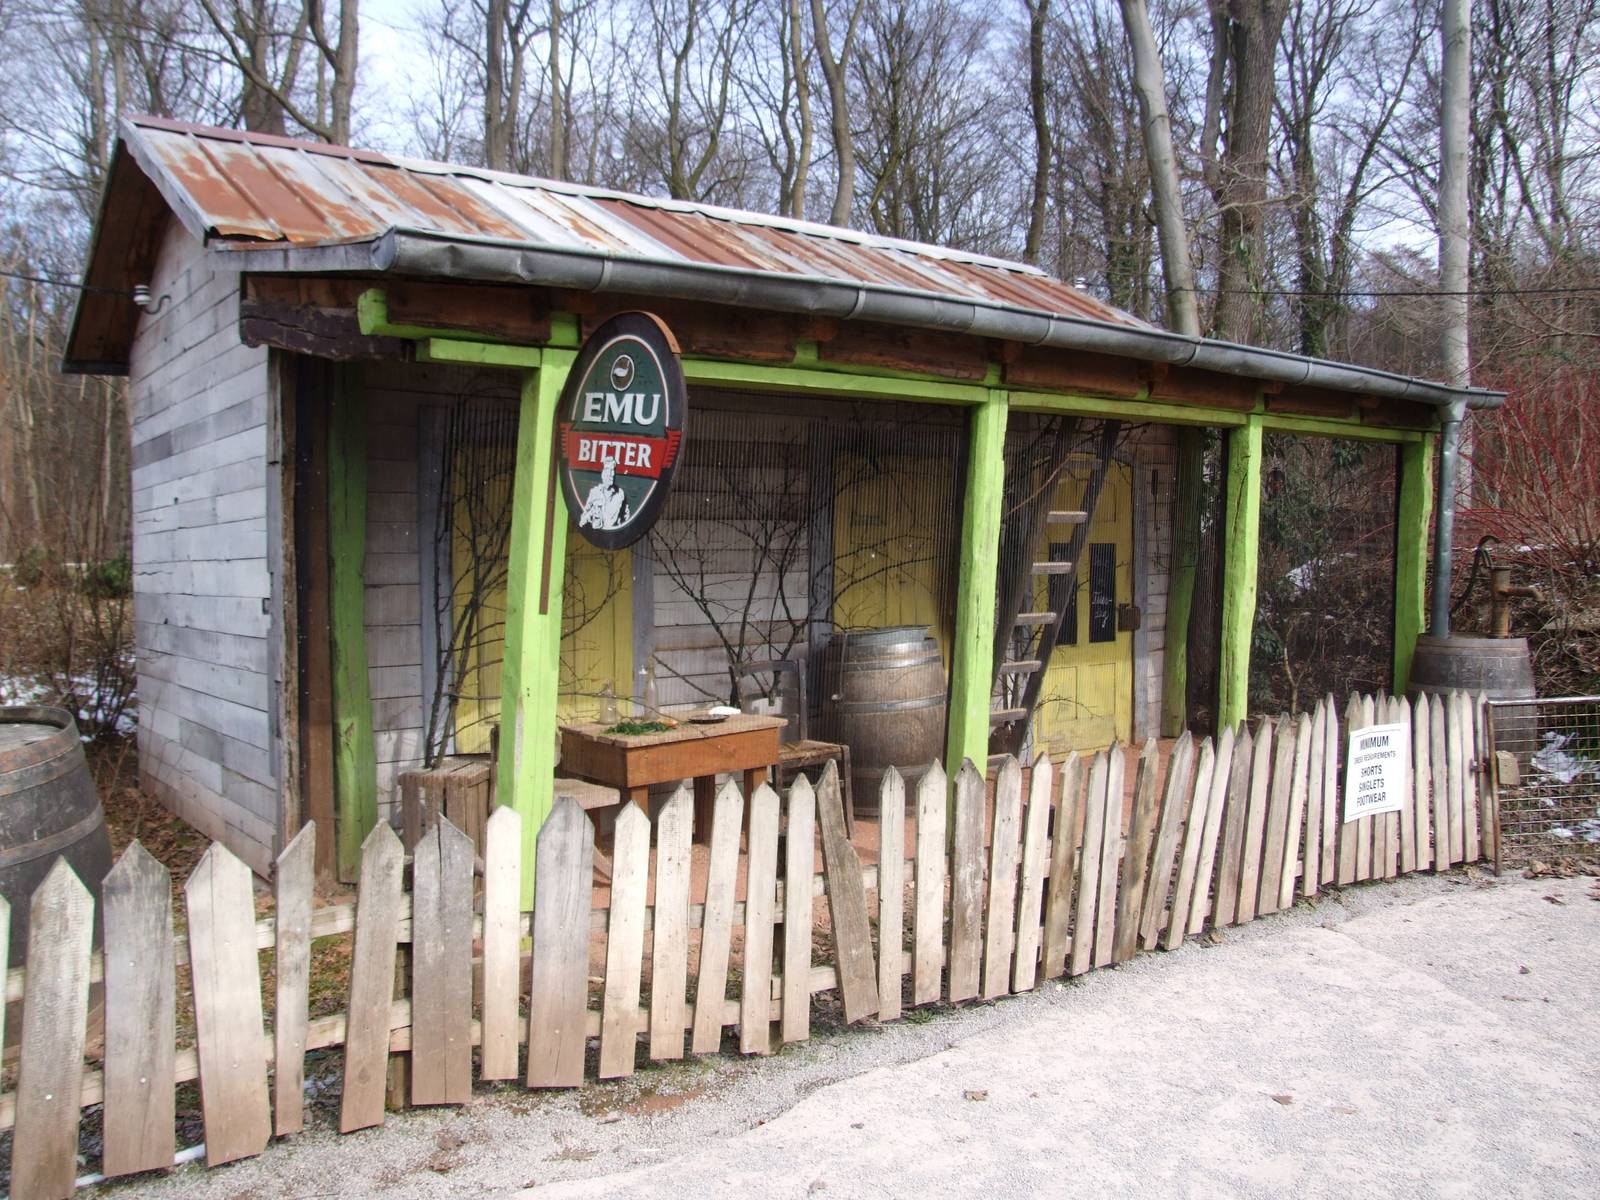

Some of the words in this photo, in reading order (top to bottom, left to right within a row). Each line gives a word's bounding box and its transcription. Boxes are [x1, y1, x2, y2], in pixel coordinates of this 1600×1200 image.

[582, 392, 661, 426] EMU
[578, 439, 652, 468] BITTER
[1360, 736, 1389, 750] MINIMUM
[1361, 765, 1383, 777] SHORTS
[1359, 778, 1384, 792] SINGLETS
[1357, 792, 1386, 806] FOOTWEAR
